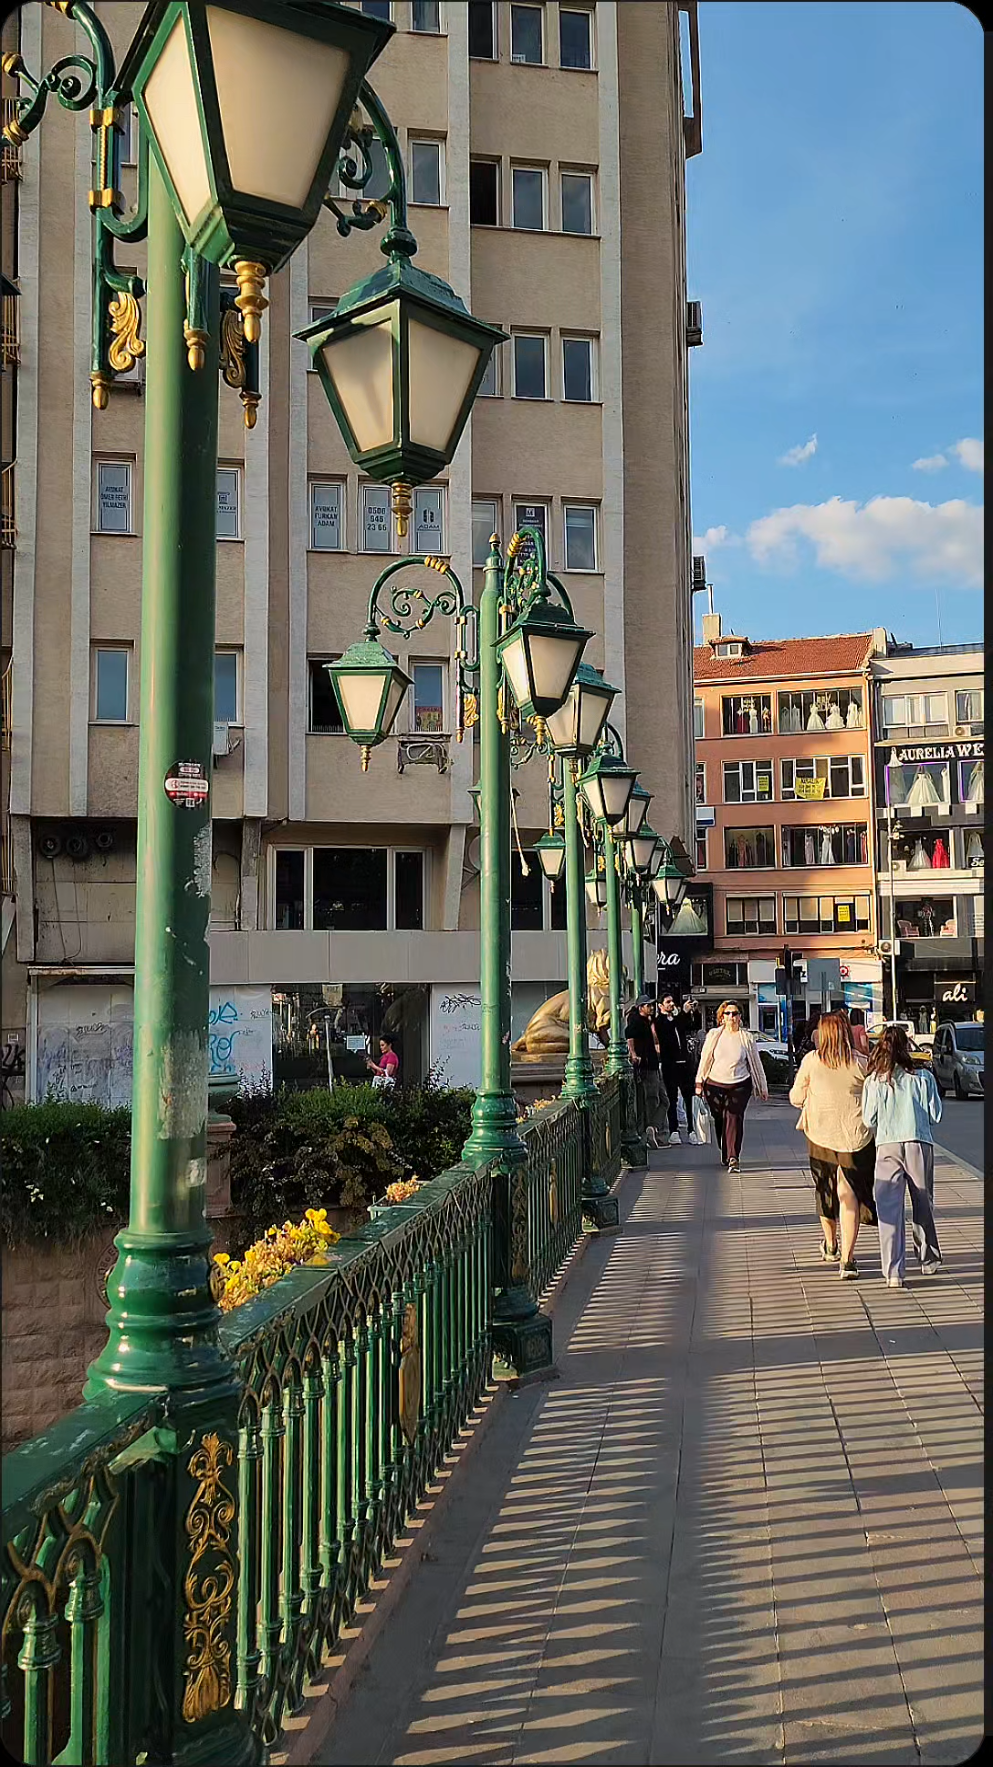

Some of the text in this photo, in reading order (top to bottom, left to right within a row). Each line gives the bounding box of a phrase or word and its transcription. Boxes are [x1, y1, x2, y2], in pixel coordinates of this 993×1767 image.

[314, 512, 338, 520] FURKAN
[899, 745, 956, 761] AURELIA
[656, 951, 681, 966] ra
[942, 982, 968, 1002] ali
